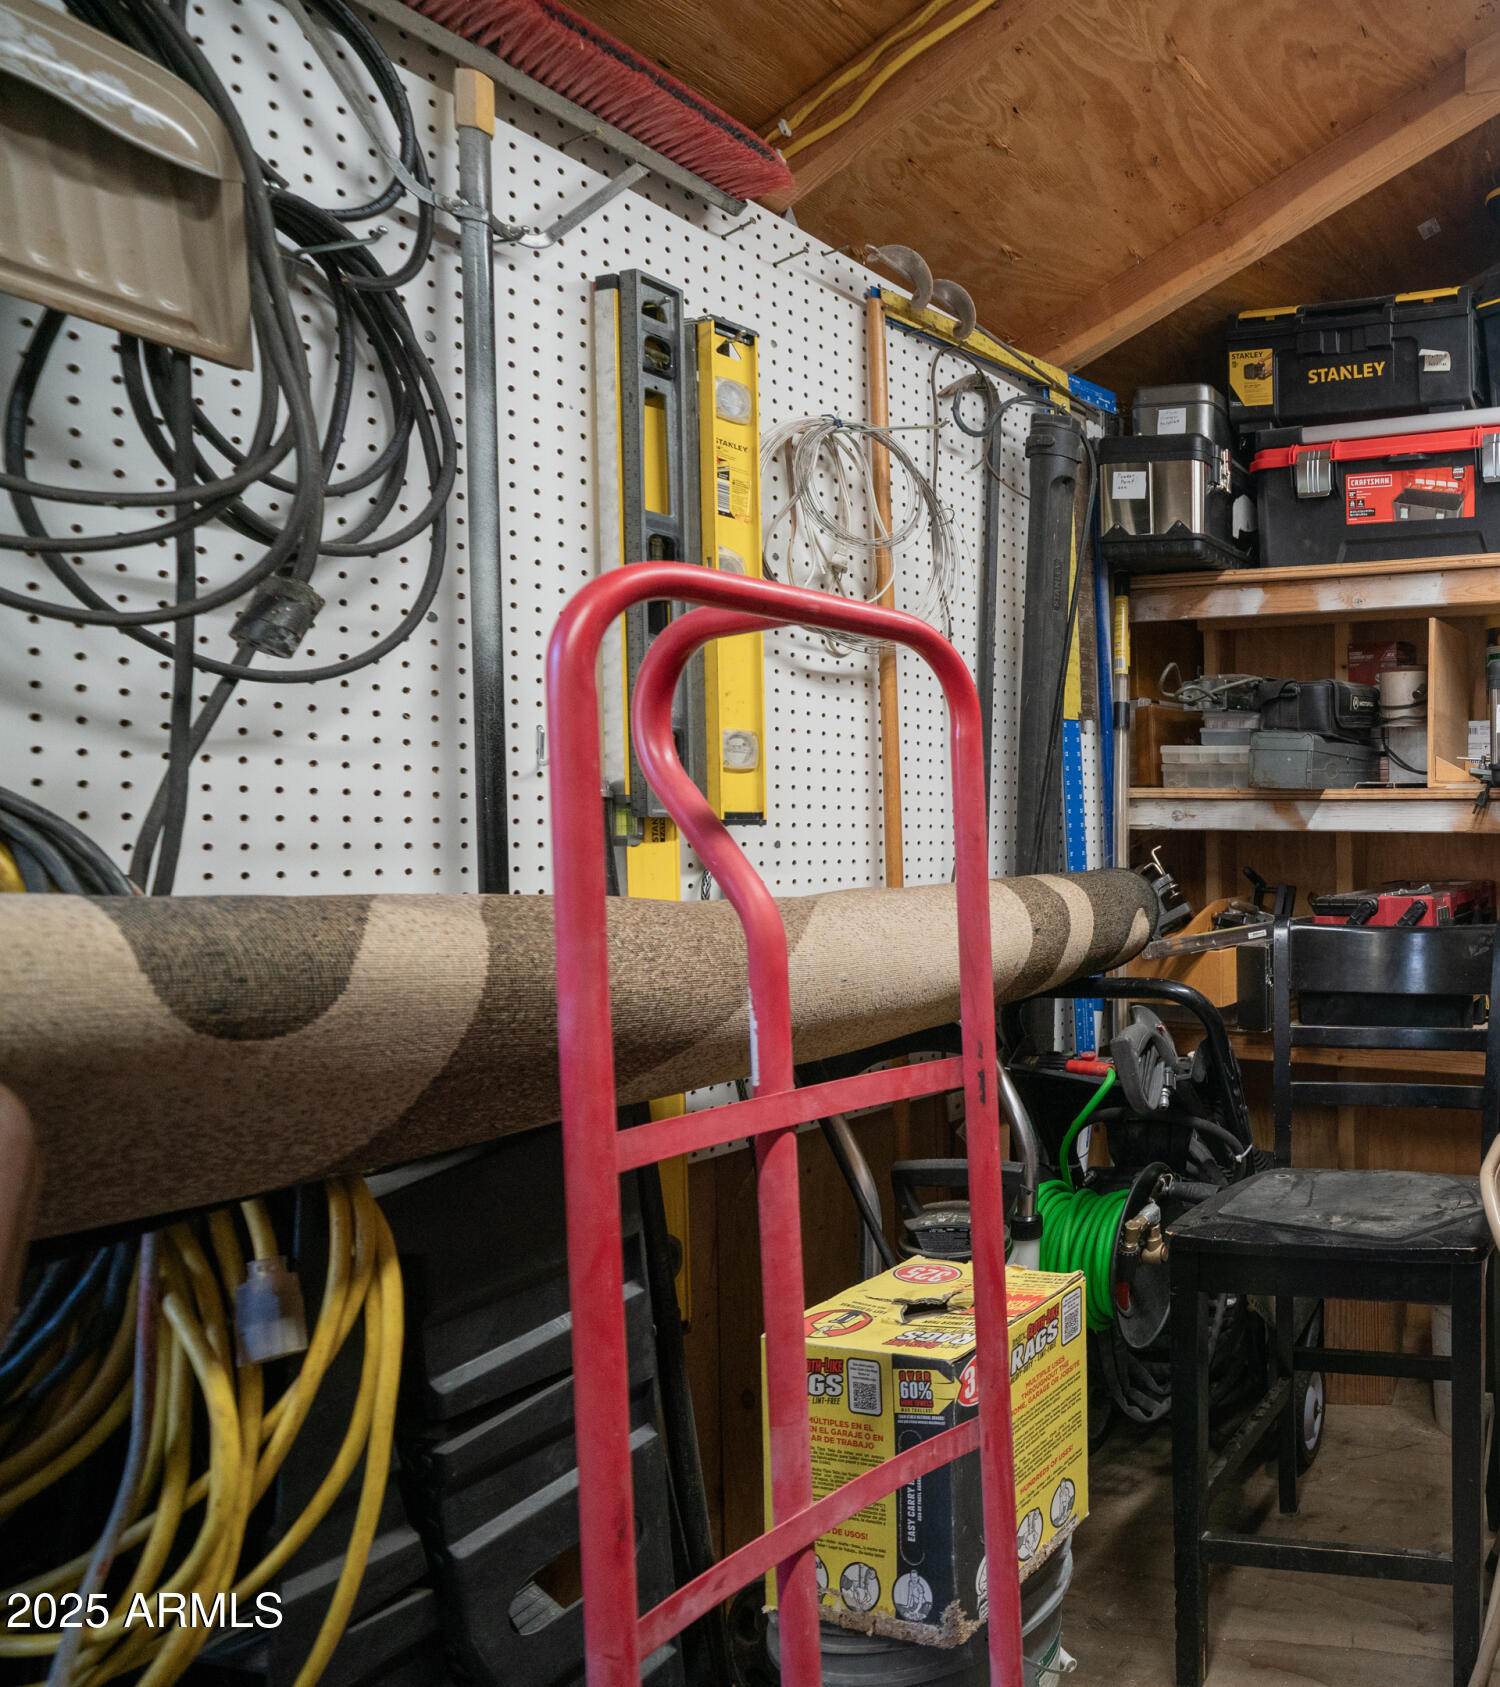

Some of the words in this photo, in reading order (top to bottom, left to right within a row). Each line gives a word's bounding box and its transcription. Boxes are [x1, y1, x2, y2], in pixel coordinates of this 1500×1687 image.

[1232, 351, 1263, 360] STANLEY
[1308, 361, 1386, 384] STANLEY
[716, 437, 748, 452] STANLEY
[1350, 477, 1390, 487] CRAFTSMAN
[652, 817, 661, 842] STAN
[901, 1266, 952, 1283] 325
[895, 1330, 976, 1345] RAGS
[1010, 1317, 1060, 1377] RAGS
[807, 1357, 844, 1374] OTH-LIKE
[899, 1370, 931, 1382] OVER
[808, 1373, 844, 1397] GS
[900, 1381, 932, 1400] 60%
[809, 1415, 849, 1429] MÚLTIPLES
[851, 1420, 863, 1431] EN
[863, 1423, 874, 1433] EL
[818, 1427, 829, 1435] EL
[830, 1428, 864, 1440] GARAJE
[872, 1434, 884, 1443] EN
[823, 1436, 835, 1445] DE
[836, 1438, 875, 1450] TRABAJO
[907, 1486, 916, 1518] CARRY
[831, 1527, 843, 1536] DE
[844, 1530, 869, 1540] USOS!
[907, 1519, 916, 1542] EASY
